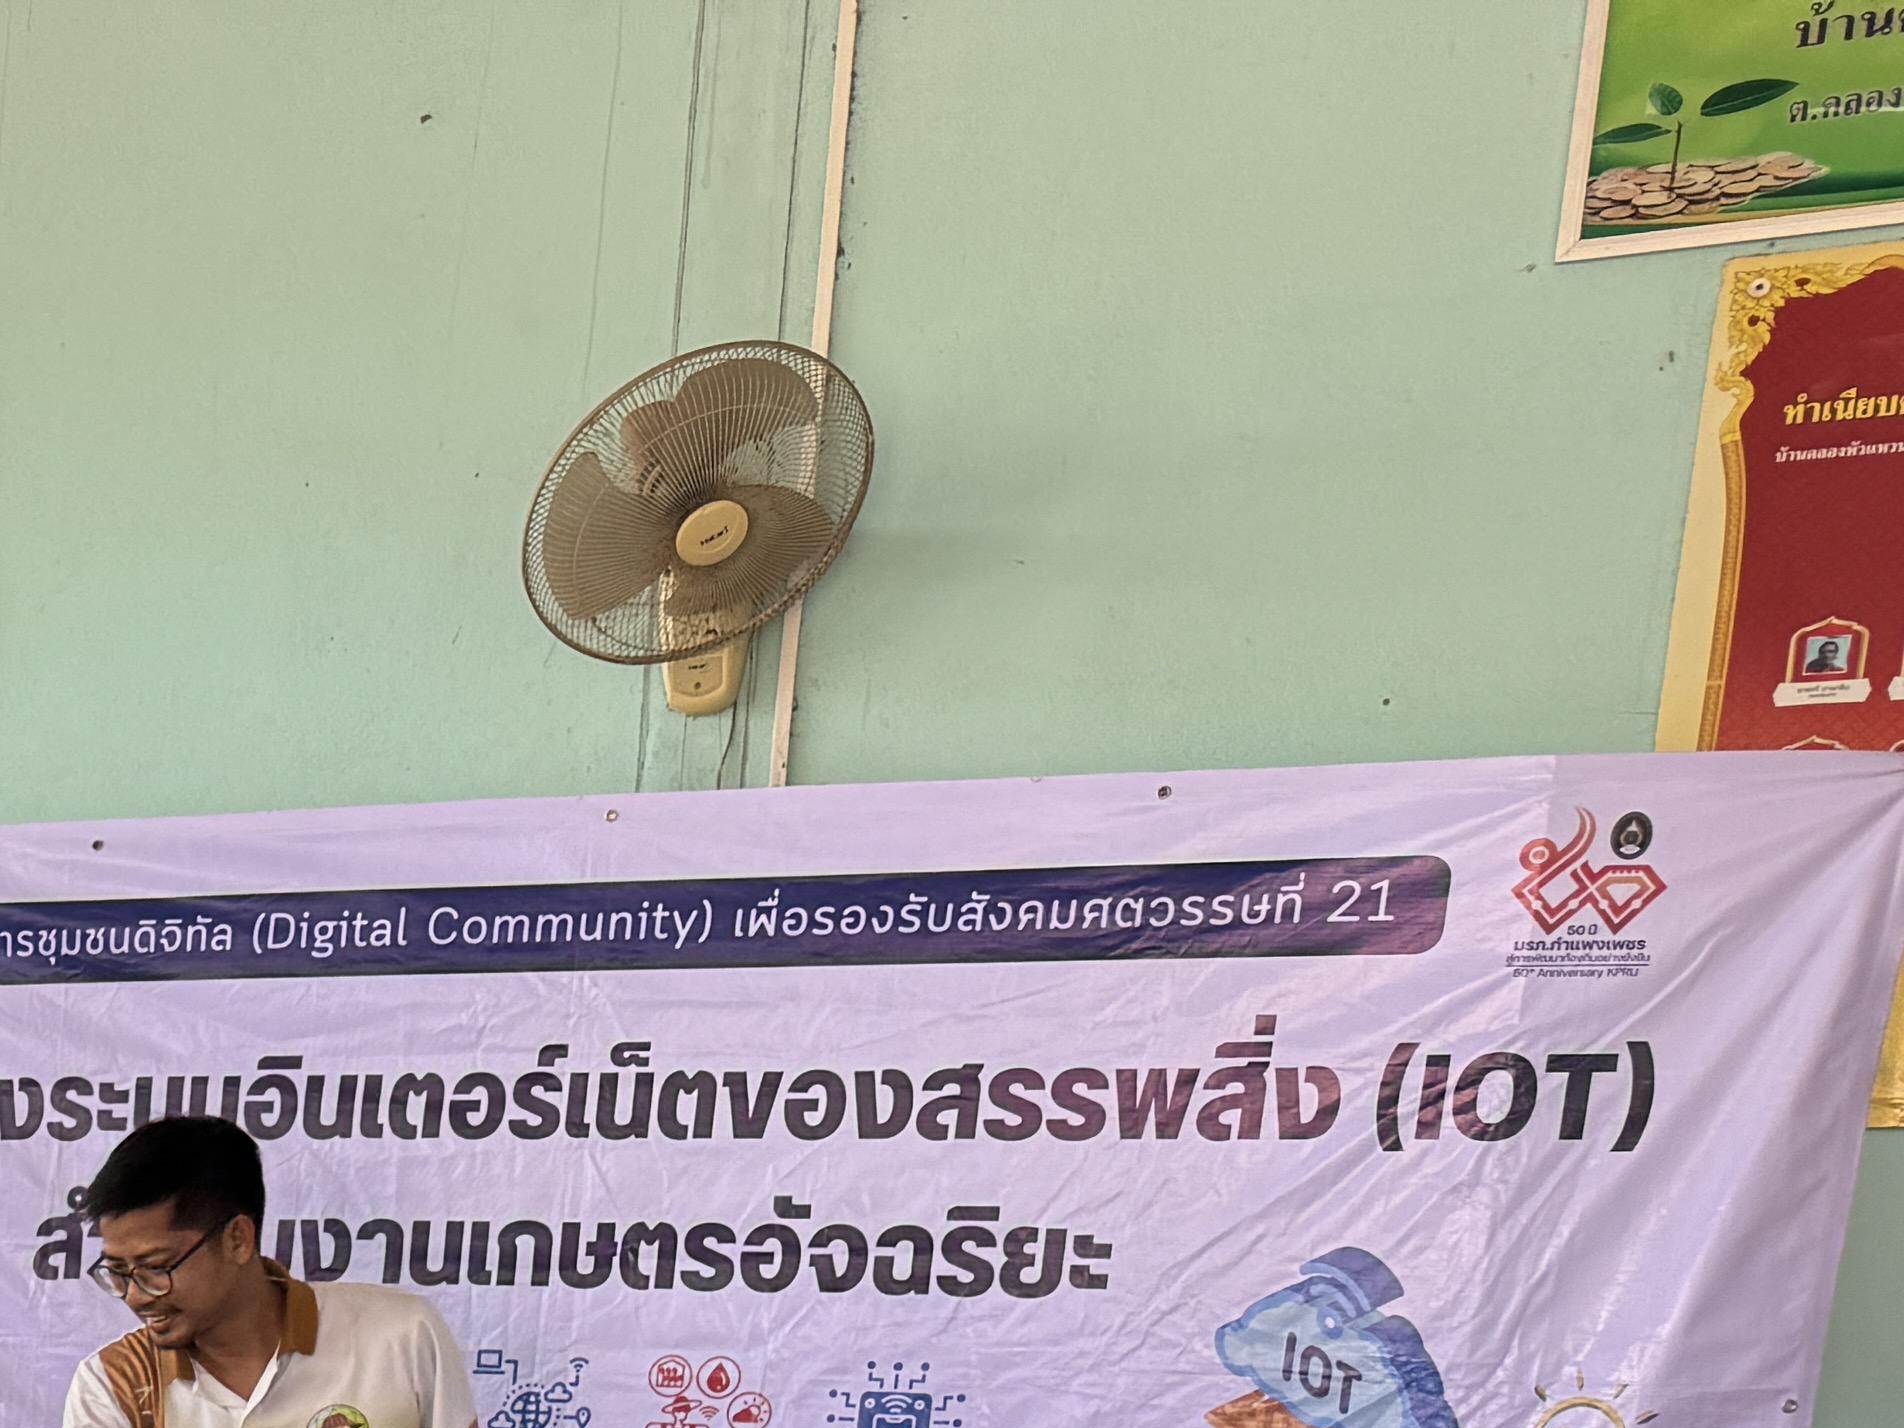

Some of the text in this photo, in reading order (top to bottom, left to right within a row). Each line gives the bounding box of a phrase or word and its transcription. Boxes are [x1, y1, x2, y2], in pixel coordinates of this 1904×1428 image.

[1795, 0, 1904, 48] บ้าน
[1784, 387, 1904, 425] ทำเนียบ
[252, 904, 408, 959] (Digital
[426, 899, 714, 950] Community)
[733, 871, 1307, 938] เพื่อรองรับสังคมศตวรรษที่
[1325, 877, 1395, 924] 21
[1513, 937, 1647, 952] มรภ.กำแพงเพชร
[1375, 1040, 1655, 1153] (IOT)
[1280, 1331, 1363, 1415] IOT
